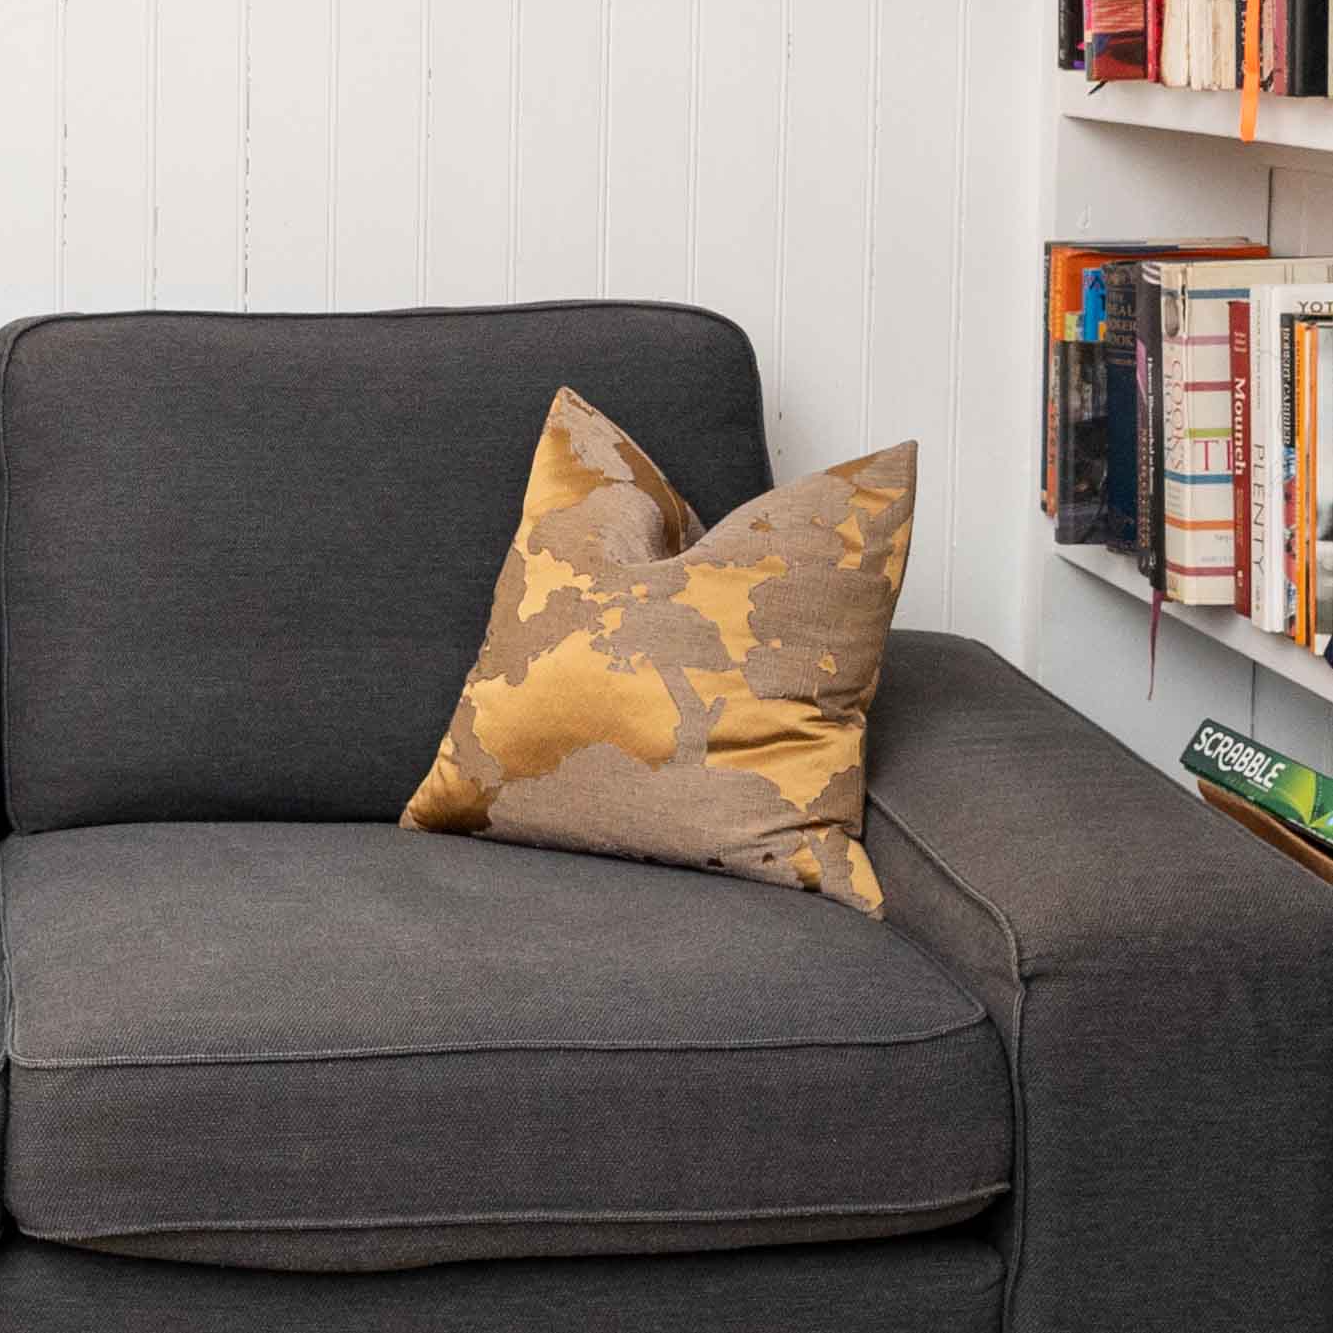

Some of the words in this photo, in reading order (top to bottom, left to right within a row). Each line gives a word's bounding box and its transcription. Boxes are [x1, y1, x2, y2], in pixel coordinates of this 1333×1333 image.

[1282, 327, 1291, 382] ROBERT
[1282, 383, 1291, 445] CARRIER
[1253, 443, 1266, 577] PLENTY
[1193, 726, 1286, 789] SCRABBLE
